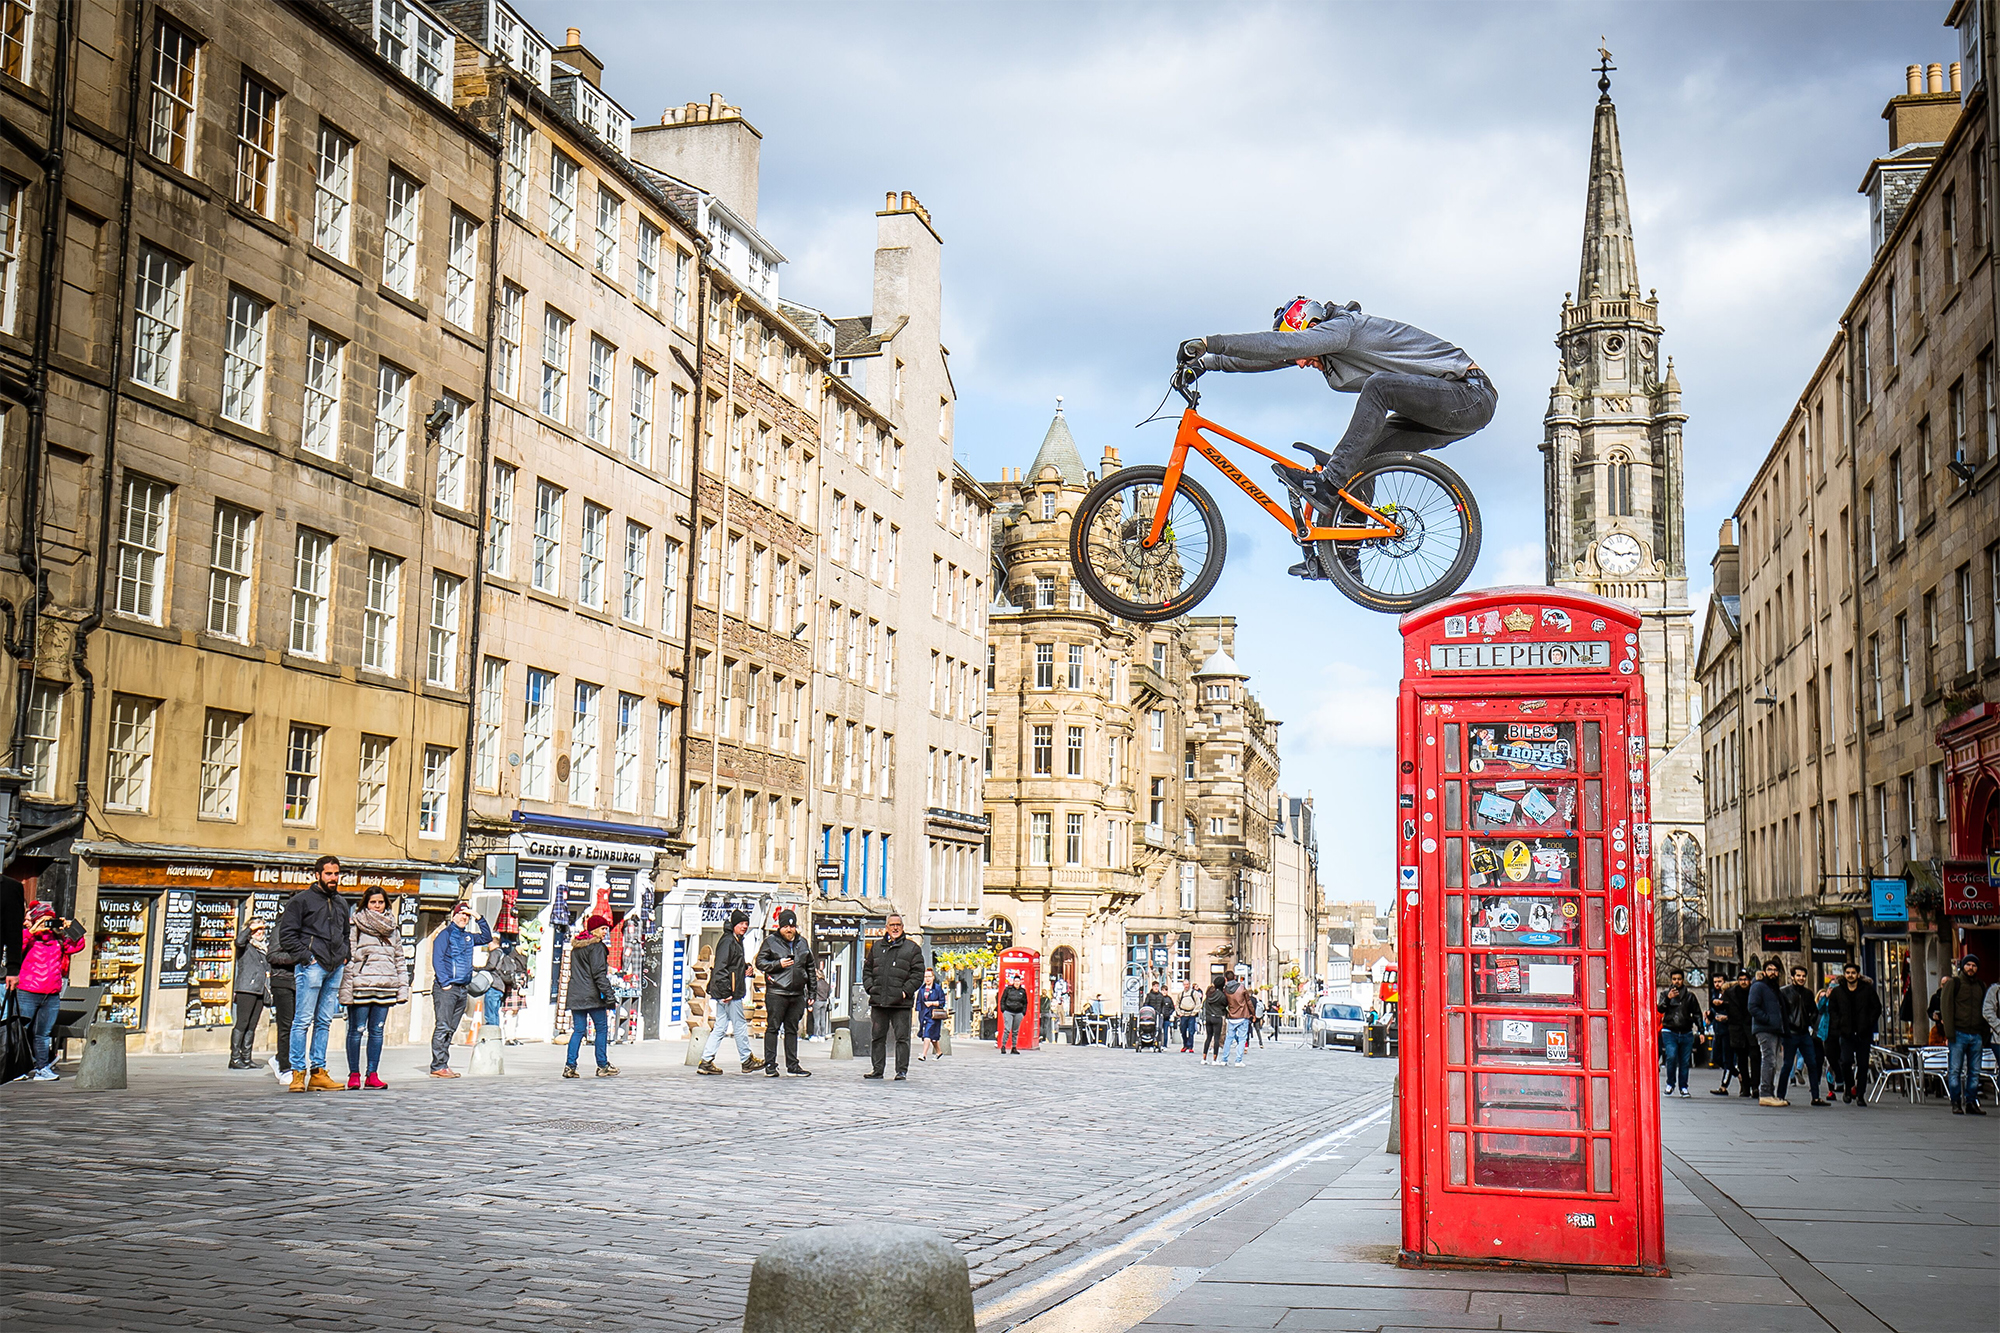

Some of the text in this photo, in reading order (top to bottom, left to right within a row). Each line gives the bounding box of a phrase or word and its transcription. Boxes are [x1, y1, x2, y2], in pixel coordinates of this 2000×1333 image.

[1203, 448, 1273, 506] SANTA CRUZ
[1303, 480, 1316, 495] 5
[1179, 481, 1209, 512] NTINENTAL
[1438, 644, 1603, 668] TELEPHONE
[1502, 745, 1563, 765] TROPAS
[530, 842, 641, 864] CREST OF EDINBURGH
[166, 865, 214, 879] Rare Whisky
[253, 866, 279, 882] The
[281, 866, 319, 884] Whis
[1948, 872, 1990, 884] coffee
[360, 875, 404, 889] Whisky Tastings
[100, 900, 142, 912] Wines &
[196, 901, 231, 914] Scottish
[1949, 898, 1993, 911] house
[200, 916, 225, 929] Beers
[701, 909, 732, 922] EARANCE
[103, 915, 133, 931] Spirit
[1547, 1050, 1566, 1058] SVW
